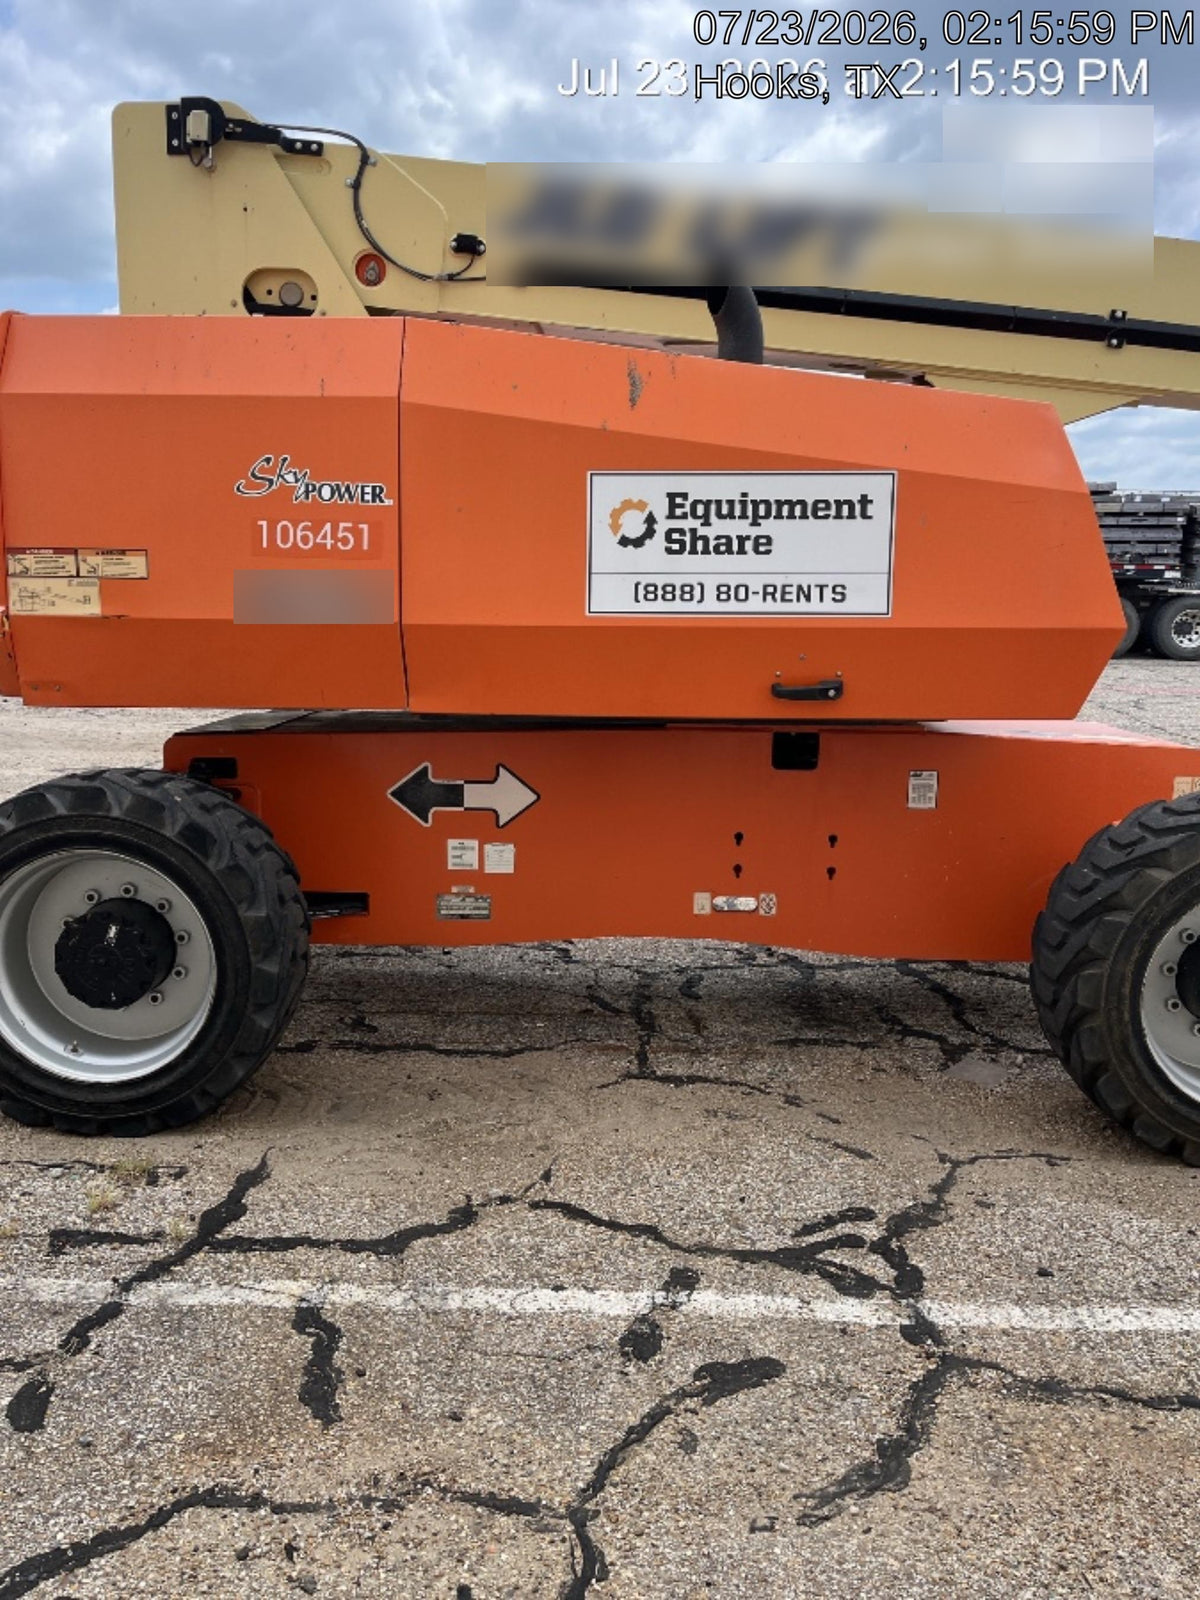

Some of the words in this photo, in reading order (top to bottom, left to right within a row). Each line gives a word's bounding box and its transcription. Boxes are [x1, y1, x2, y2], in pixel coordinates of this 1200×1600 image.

[664, 491, 874, 526] Equipment
[257, 520, 370, 551] 106451
[664, 527, 773, 555] Share
[633, 581, 706, 603] (888)
[715, 583, 848, 603] 80-RENTS
